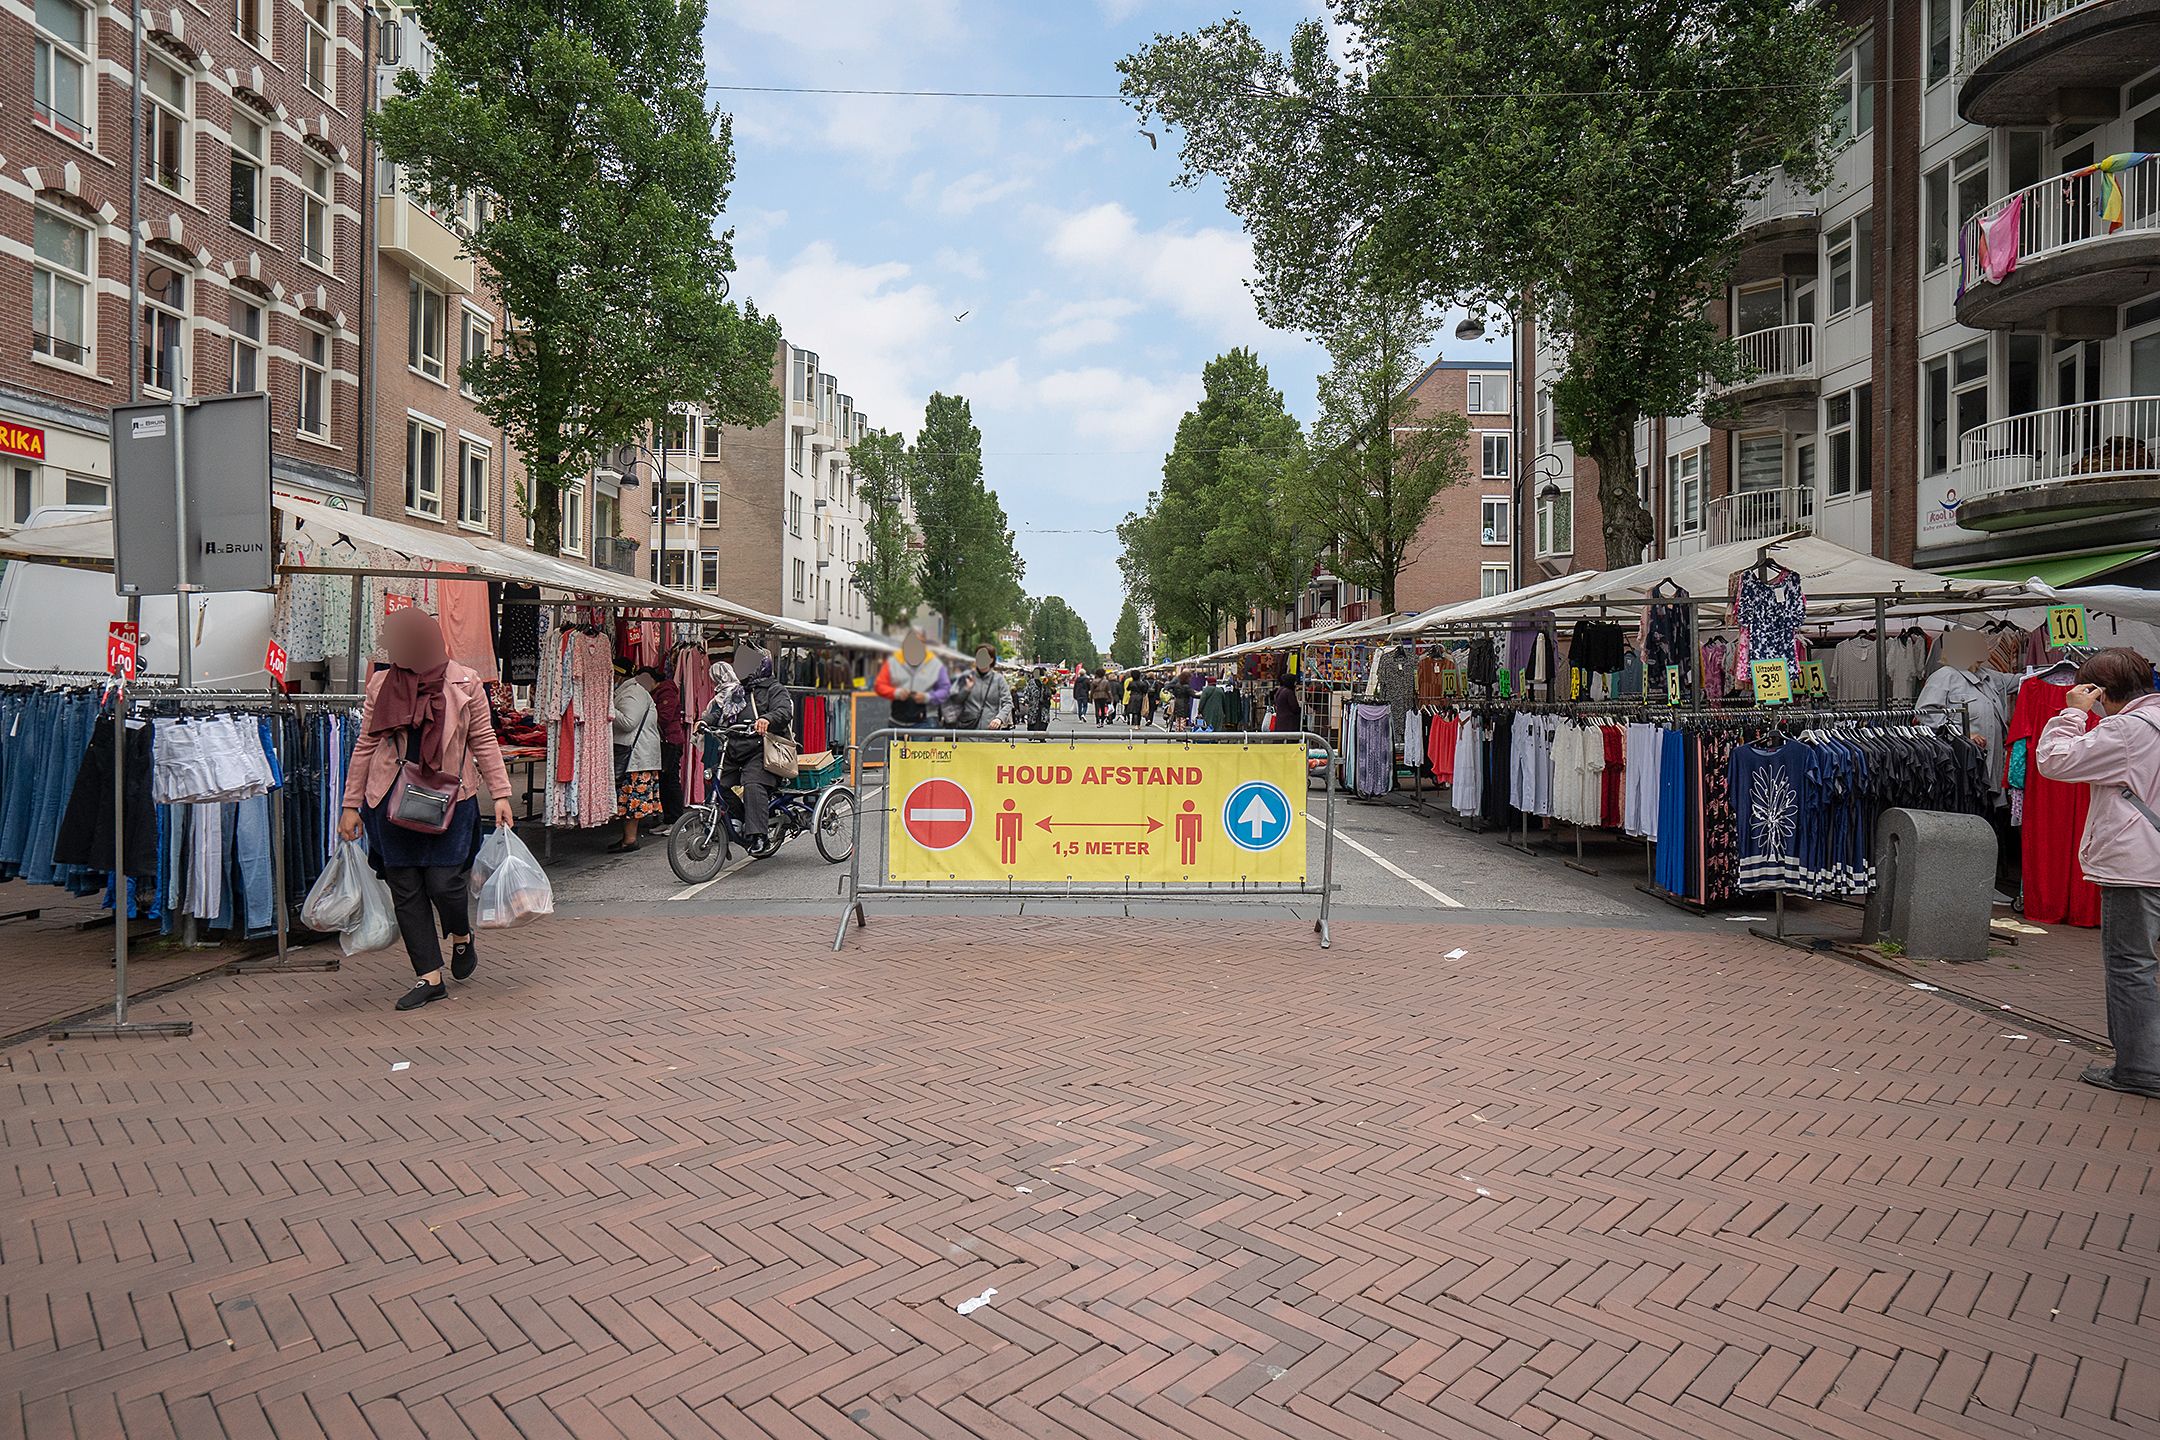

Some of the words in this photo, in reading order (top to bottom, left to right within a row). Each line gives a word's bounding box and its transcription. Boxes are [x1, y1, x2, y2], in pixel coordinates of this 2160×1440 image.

[226, 543, 263, 554] BRUIN
[996, 765, 1073, 785] HOUD
[1081, 766, 1203, 786] AFSTAND
[1052, 841, 1079, 858] 1,5
[1085, 841, 1150, 855] METER
